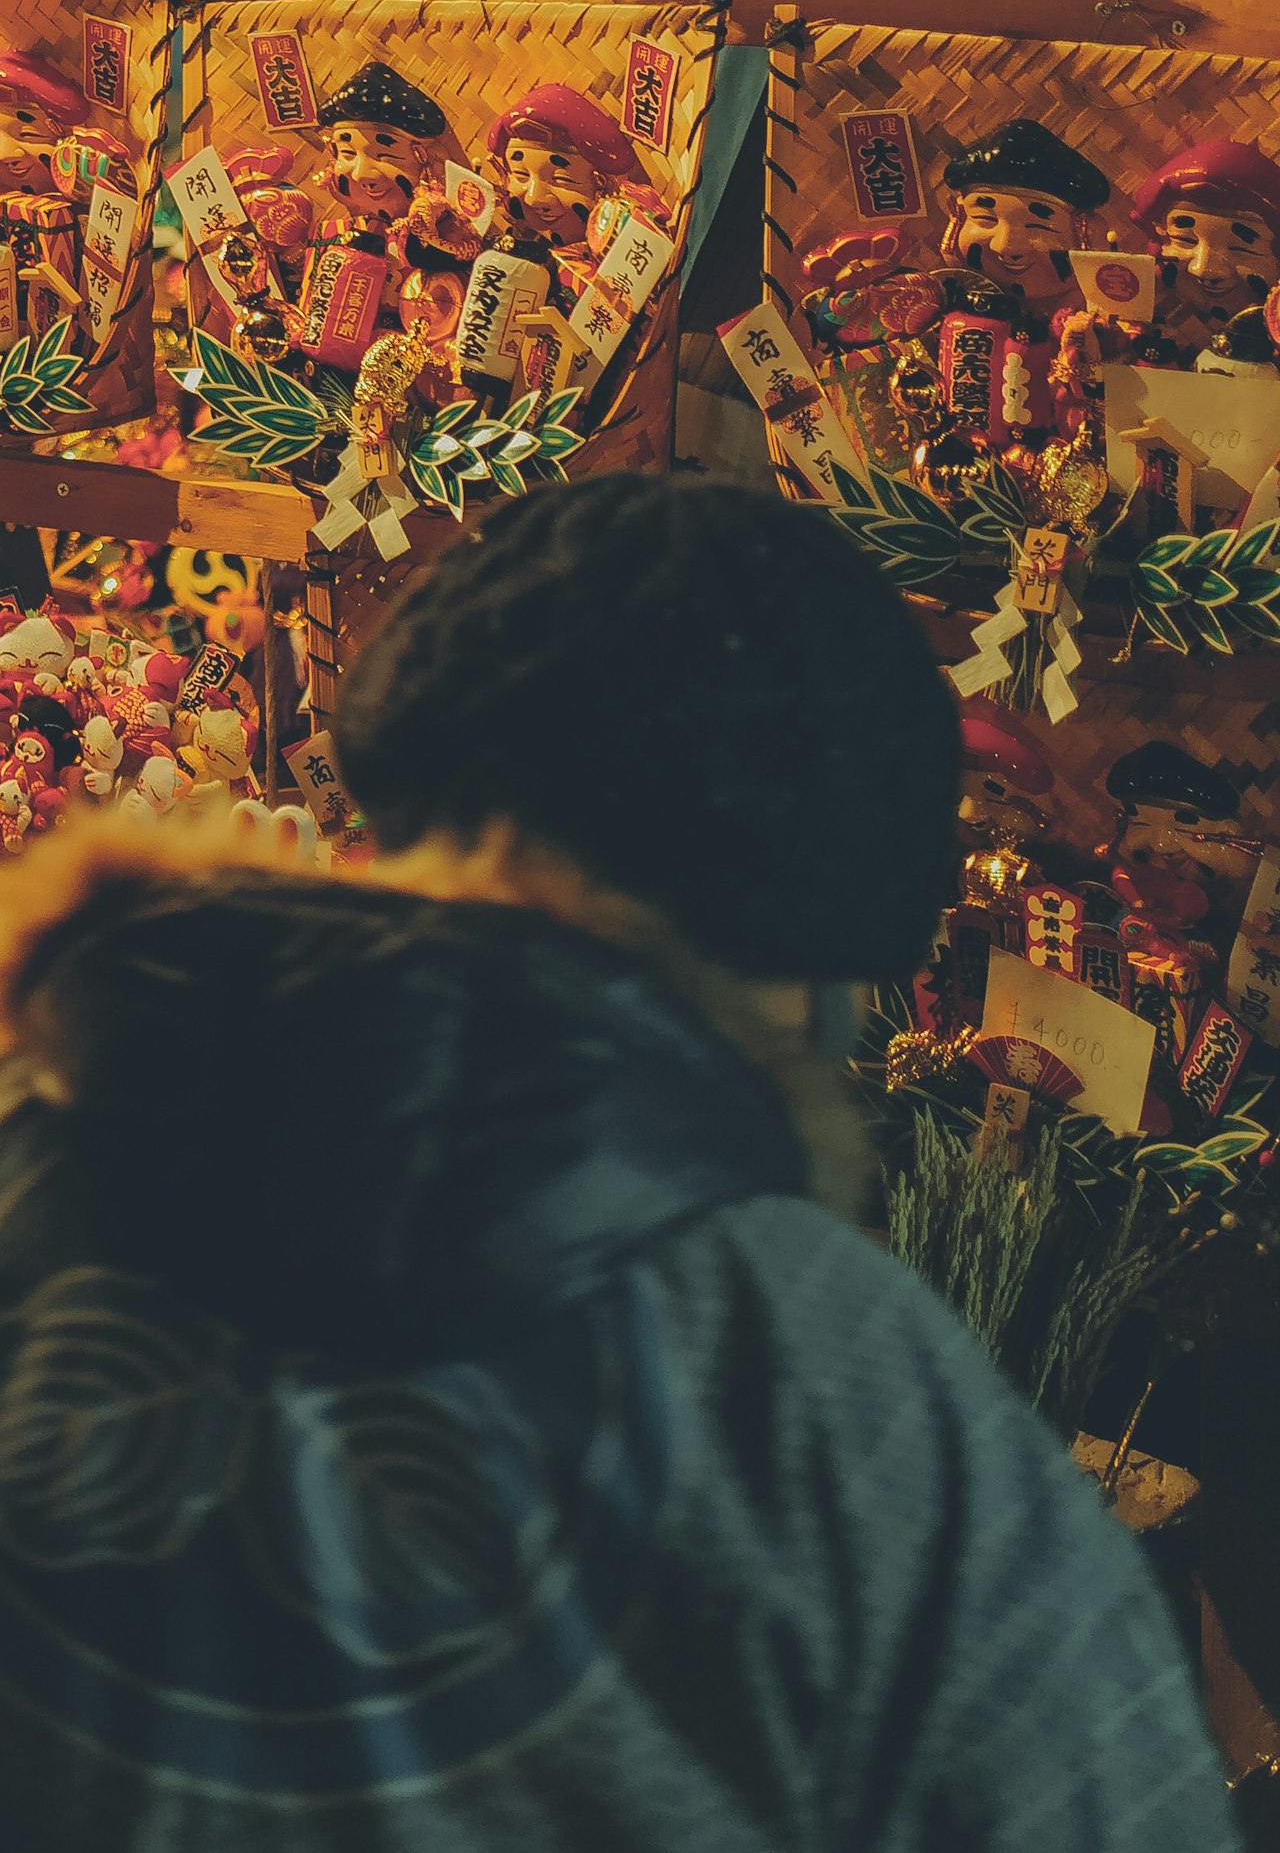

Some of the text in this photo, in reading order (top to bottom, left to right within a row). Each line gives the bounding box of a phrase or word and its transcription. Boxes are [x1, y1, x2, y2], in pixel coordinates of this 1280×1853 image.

[90, 42, 122, 106] 大吉
[264, 54, 305, 122] 大吉
[634, 66, 662, 139] 大吉
[859, 136, 908, 215] 大吉
